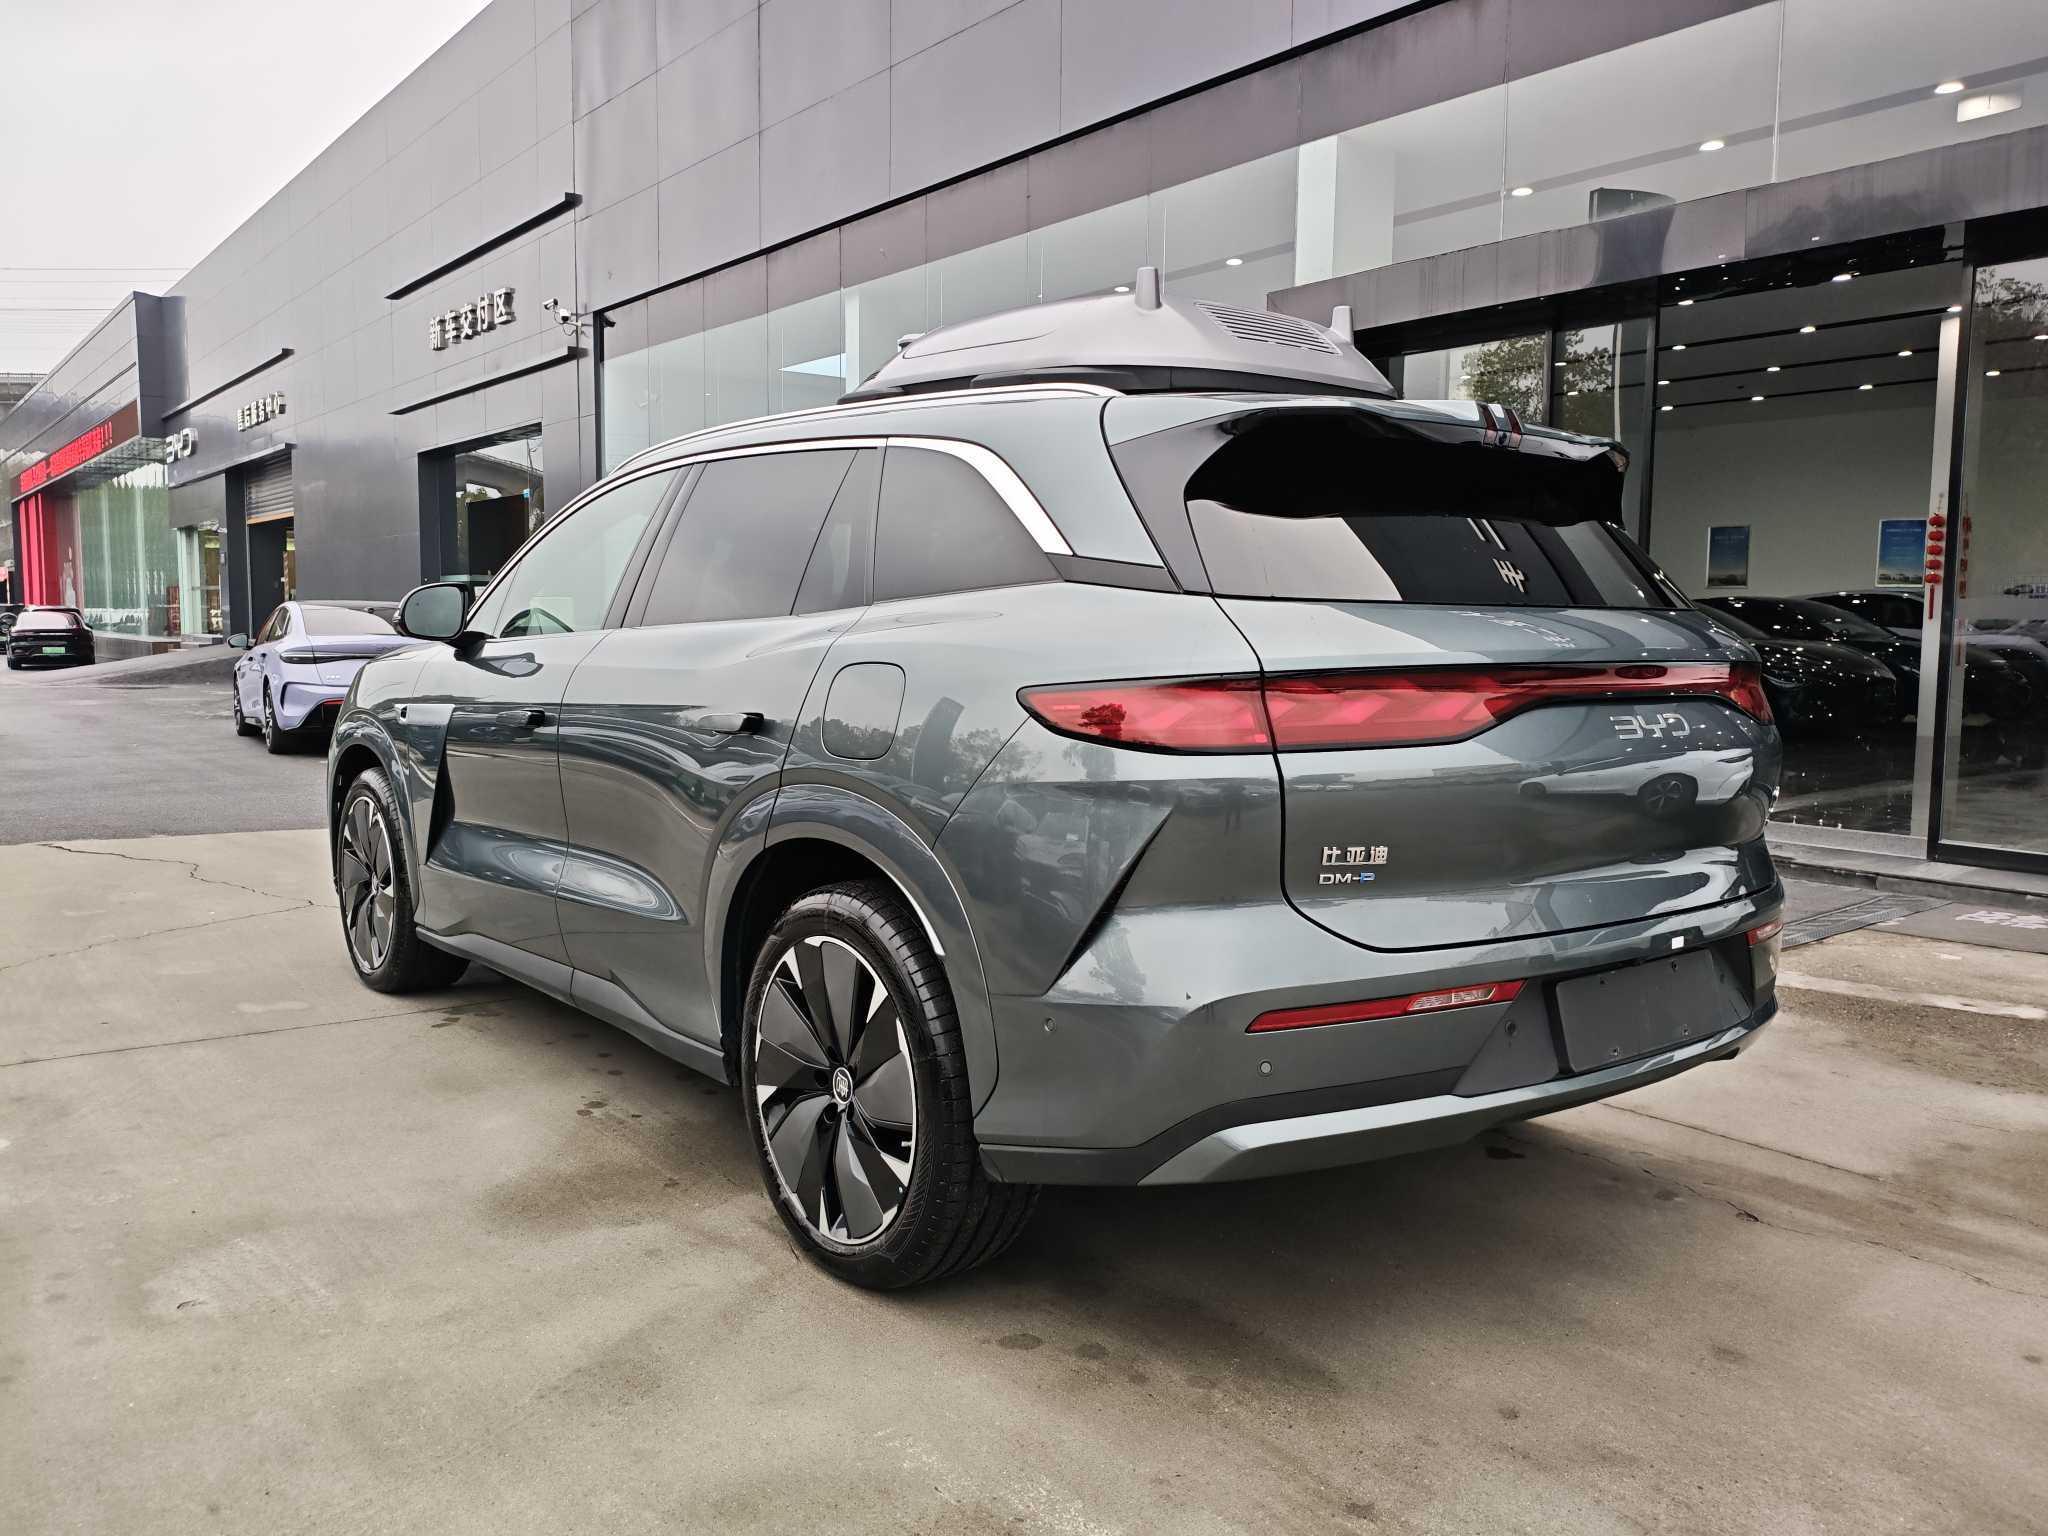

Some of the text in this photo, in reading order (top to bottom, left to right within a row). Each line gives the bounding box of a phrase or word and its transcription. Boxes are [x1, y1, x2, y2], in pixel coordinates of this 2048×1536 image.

[430, 288, 514, 350] 新车交付区
[237, 392, 283, 432] 售后服务中心
[165, 428, 195, 463] BYD
[1609, 713, 1690, 740] BYD
[1321, 845, 1388, 865] 比亚迪
